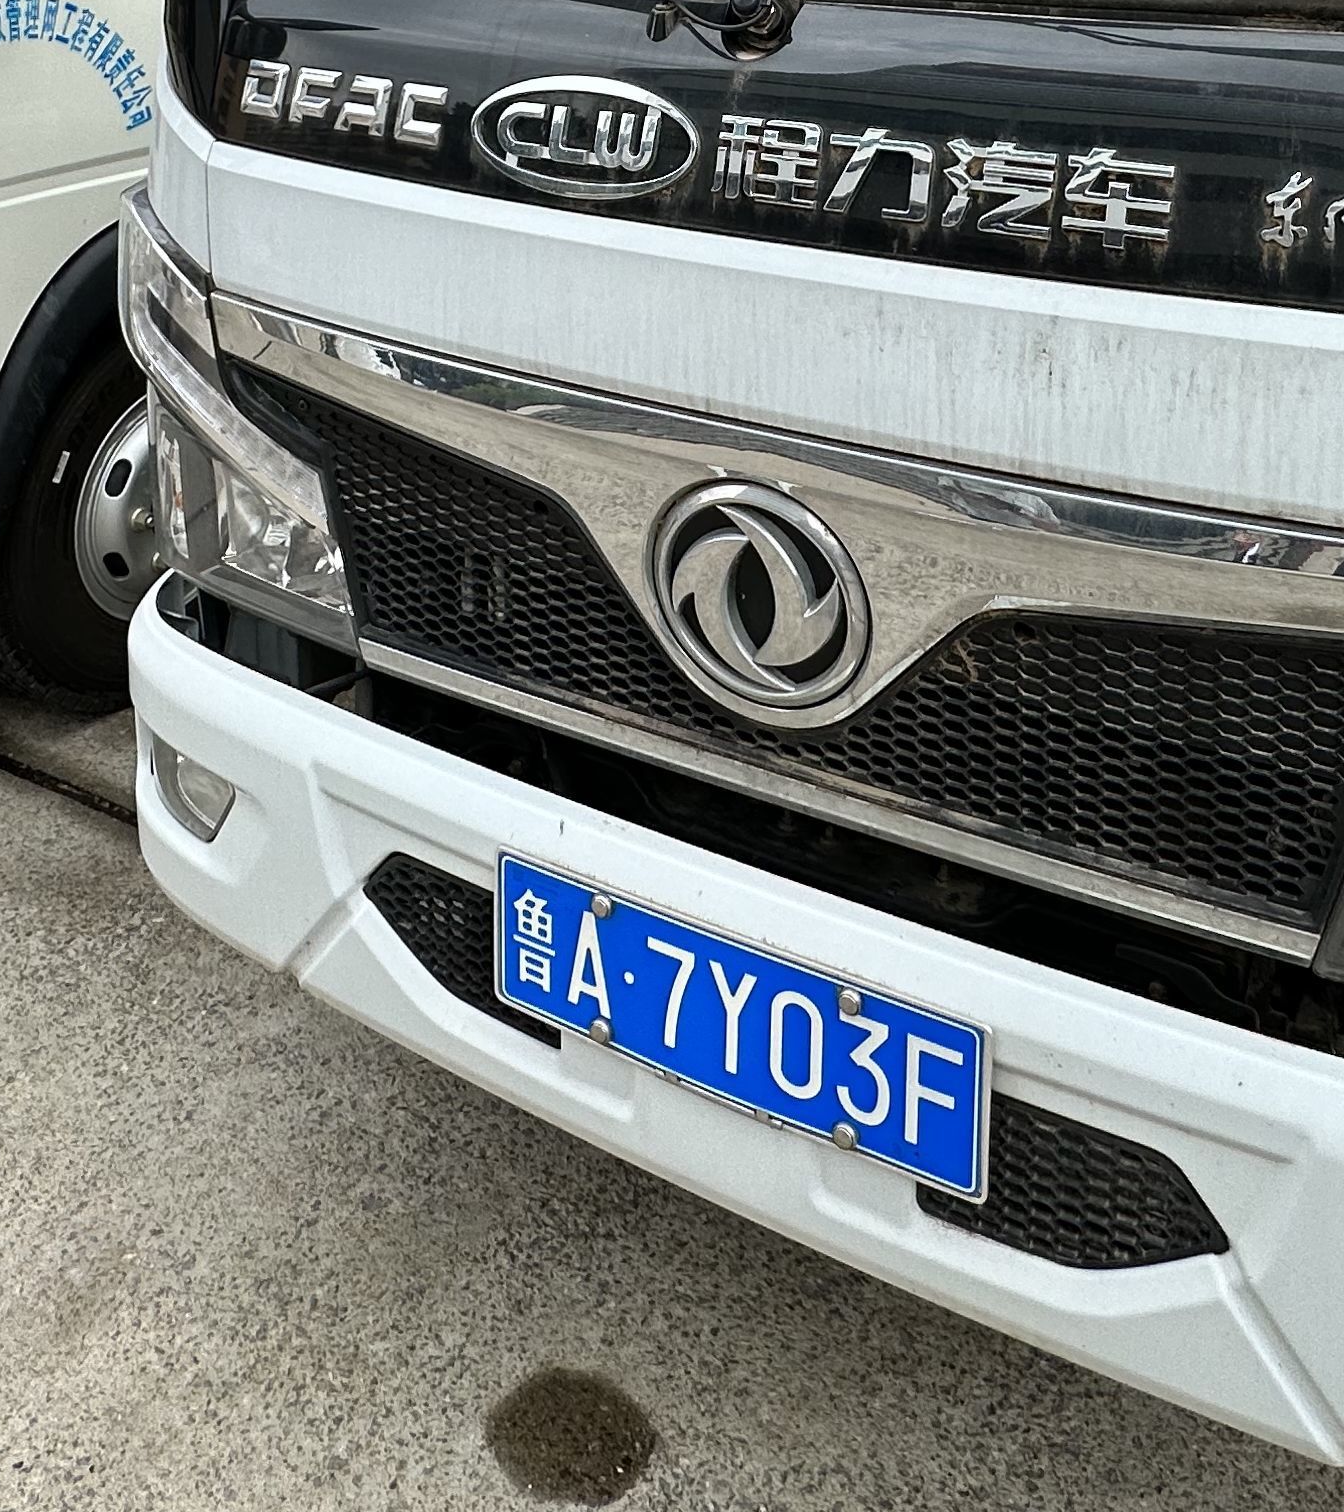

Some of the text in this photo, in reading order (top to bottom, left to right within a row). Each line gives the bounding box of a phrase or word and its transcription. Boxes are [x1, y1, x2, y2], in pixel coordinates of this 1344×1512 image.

[240, 65, 1176, 249] DFAC CLW 程力汽车
